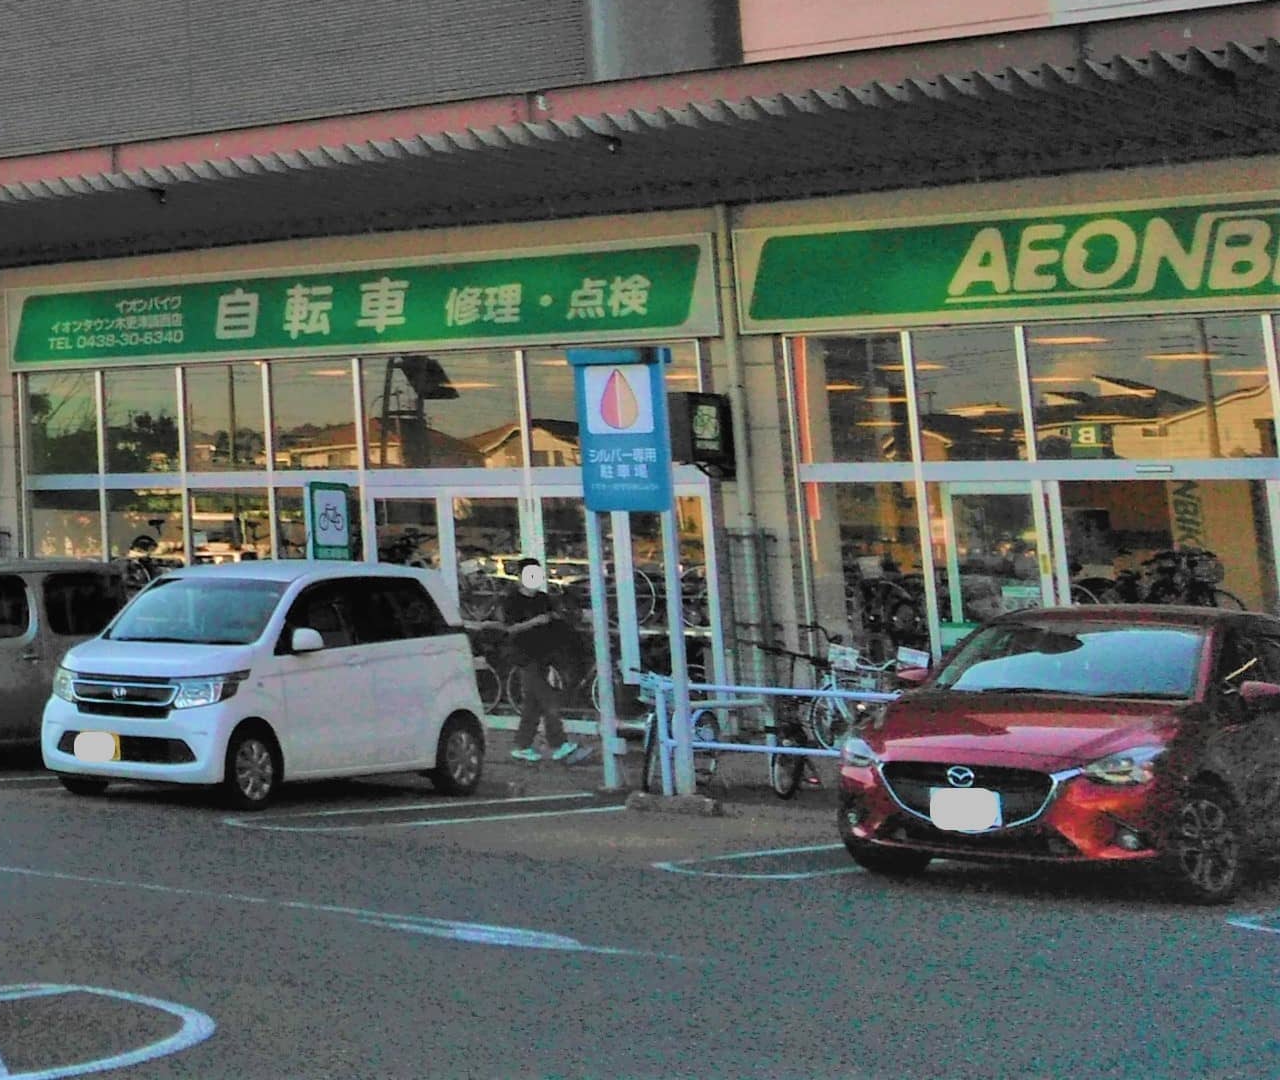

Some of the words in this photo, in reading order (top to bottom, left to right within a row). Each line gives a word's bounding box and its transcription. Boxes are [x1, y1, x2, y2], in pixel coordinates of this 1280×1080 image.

[946, 210, 1280, 300] AEONB
[215, 277, 409, 340] 自転車
[444, 274, 651, 327] 修理・点検
[48, 337, 72, 350] TEL
[587, 447, 658, 464] シルバー専用
[599, 463, 649, 480] 駐車場
